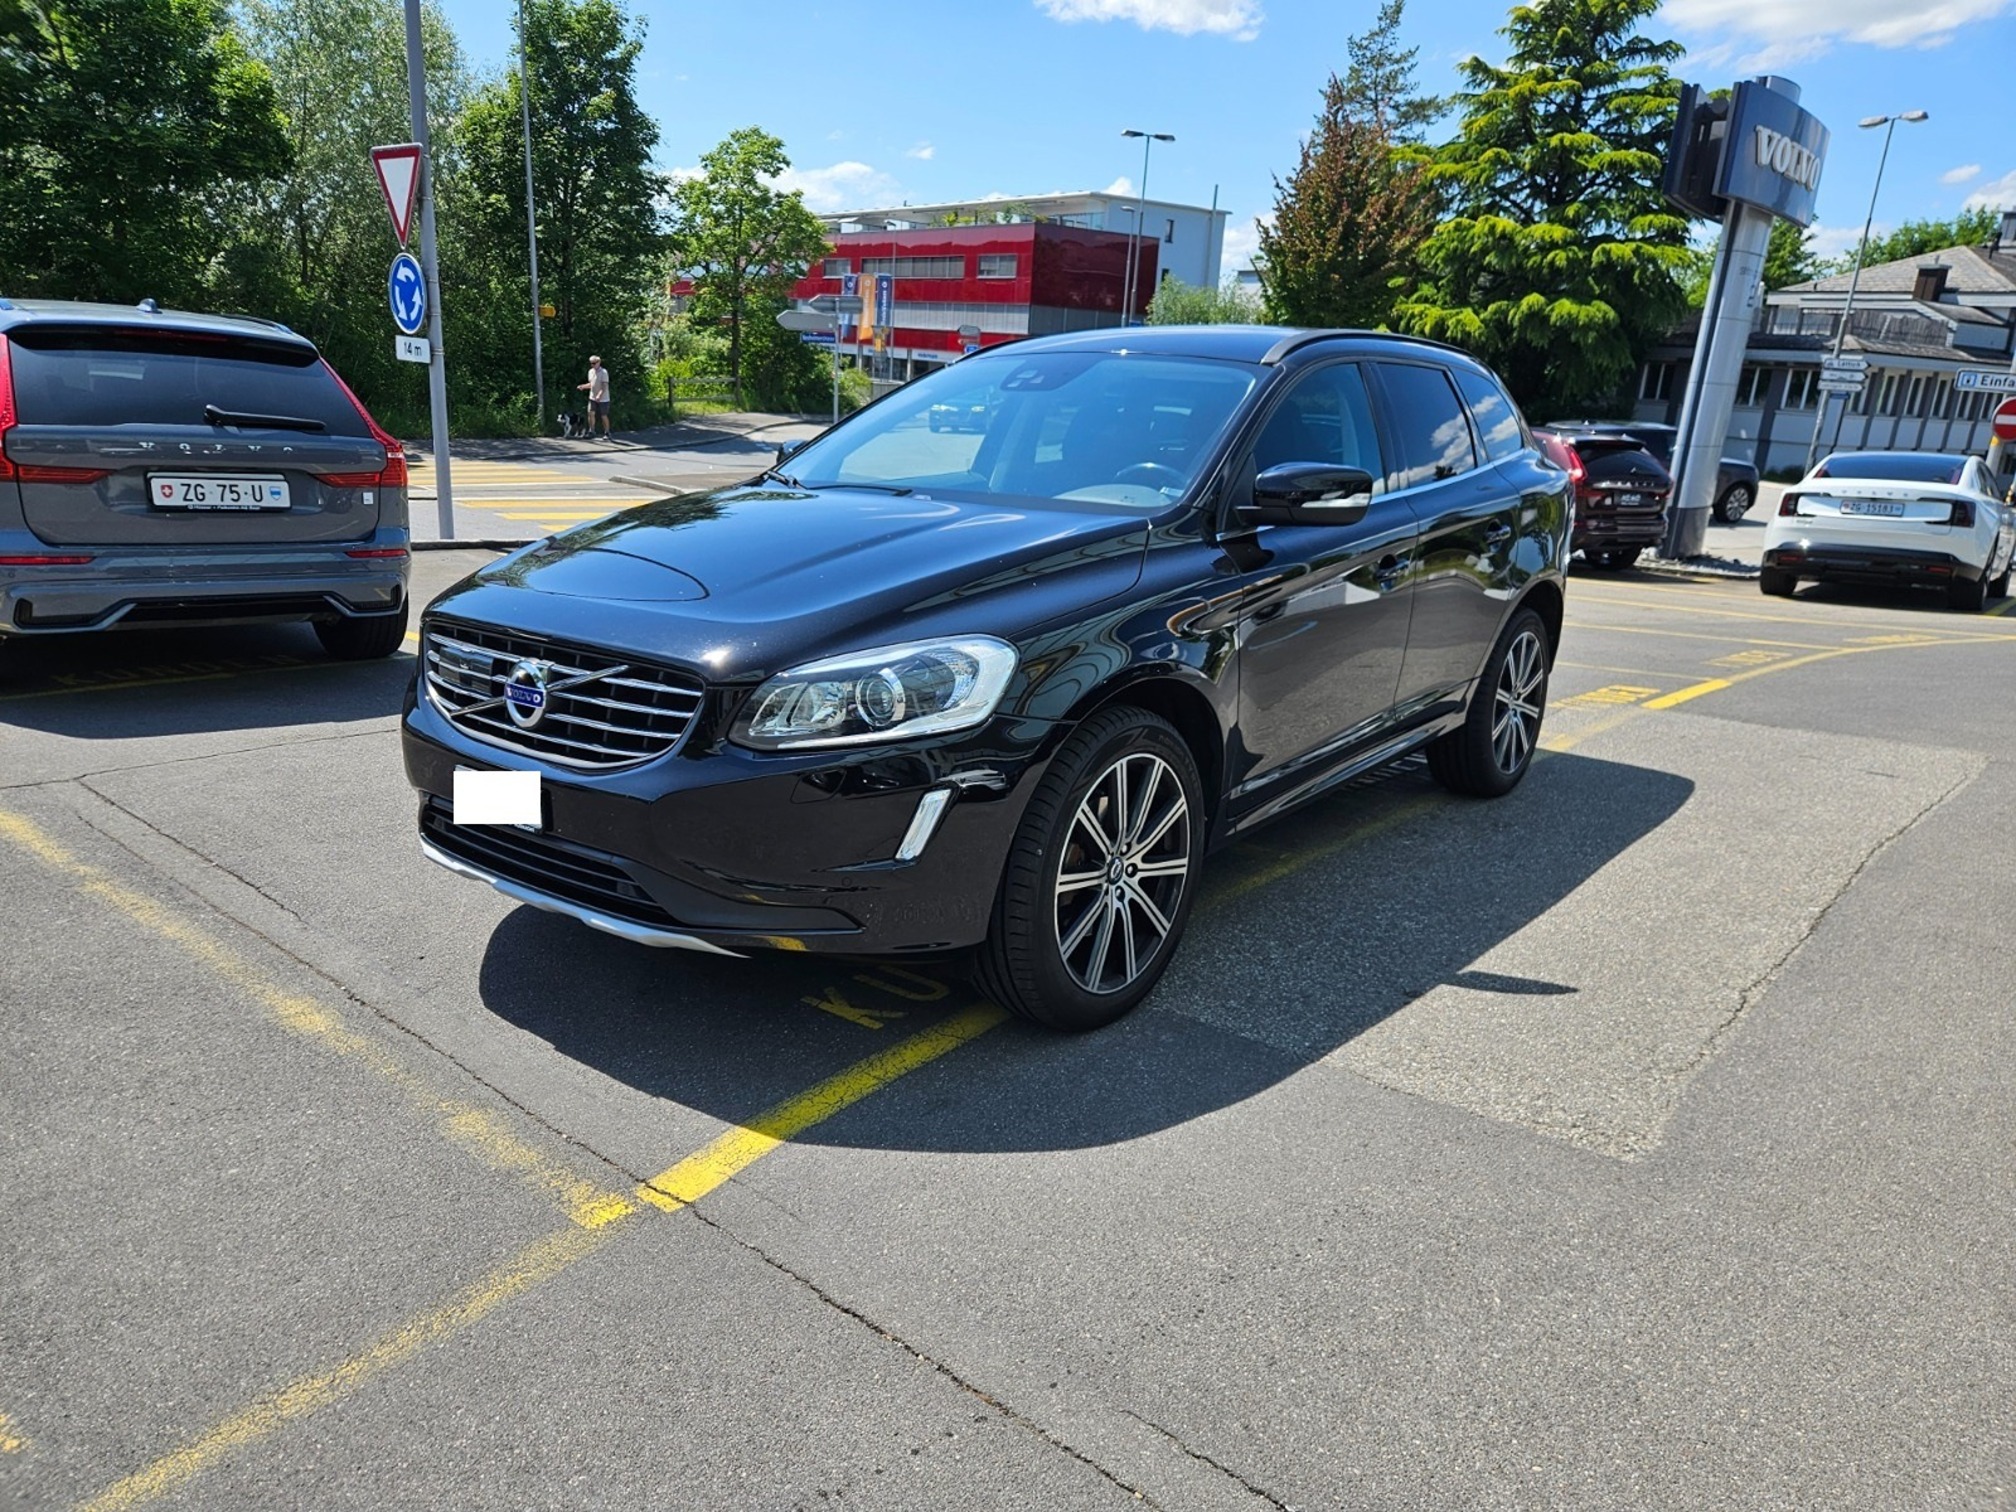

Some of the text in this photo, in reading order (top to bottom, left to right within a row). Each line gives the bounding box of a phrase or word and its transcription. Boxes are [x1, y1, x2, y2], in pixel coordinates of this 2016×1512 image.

[1755, 125, 1820, 192] VOLVO
[404, 342, 422, 356] 14 m
[180, 484, 263, 502] ZG 75 U
[506, 687, 541, 703] VOLVO
